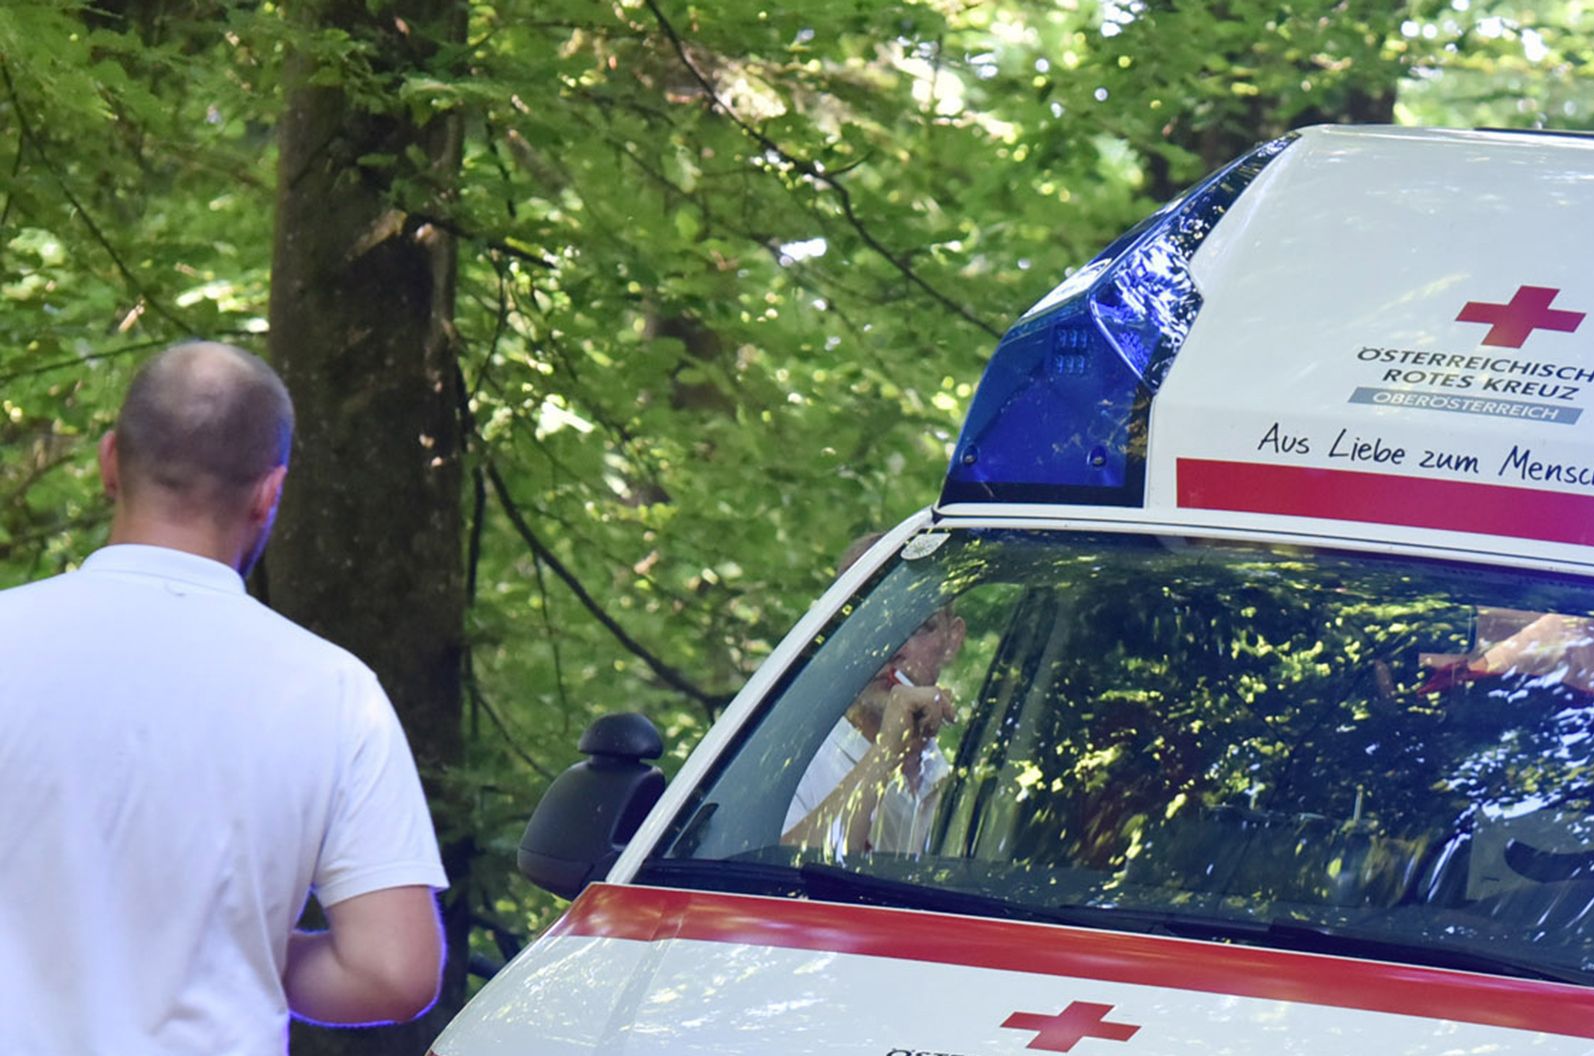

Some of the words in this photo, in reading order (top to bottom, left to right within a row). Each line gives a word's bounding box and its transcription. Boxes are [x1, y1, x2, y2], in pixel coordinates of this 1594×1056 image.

[1382, 369, 1474, 388] ROTES
[1482, 378, 1580, 400] KREUZ
[1372, 392, 1559, 421] OBERÖSTERREICH
[1257, 422, 1310, 454] Aus
[1328, 428, 1405, 464] Liebe
[1419, 450, 1479, 474] zum
